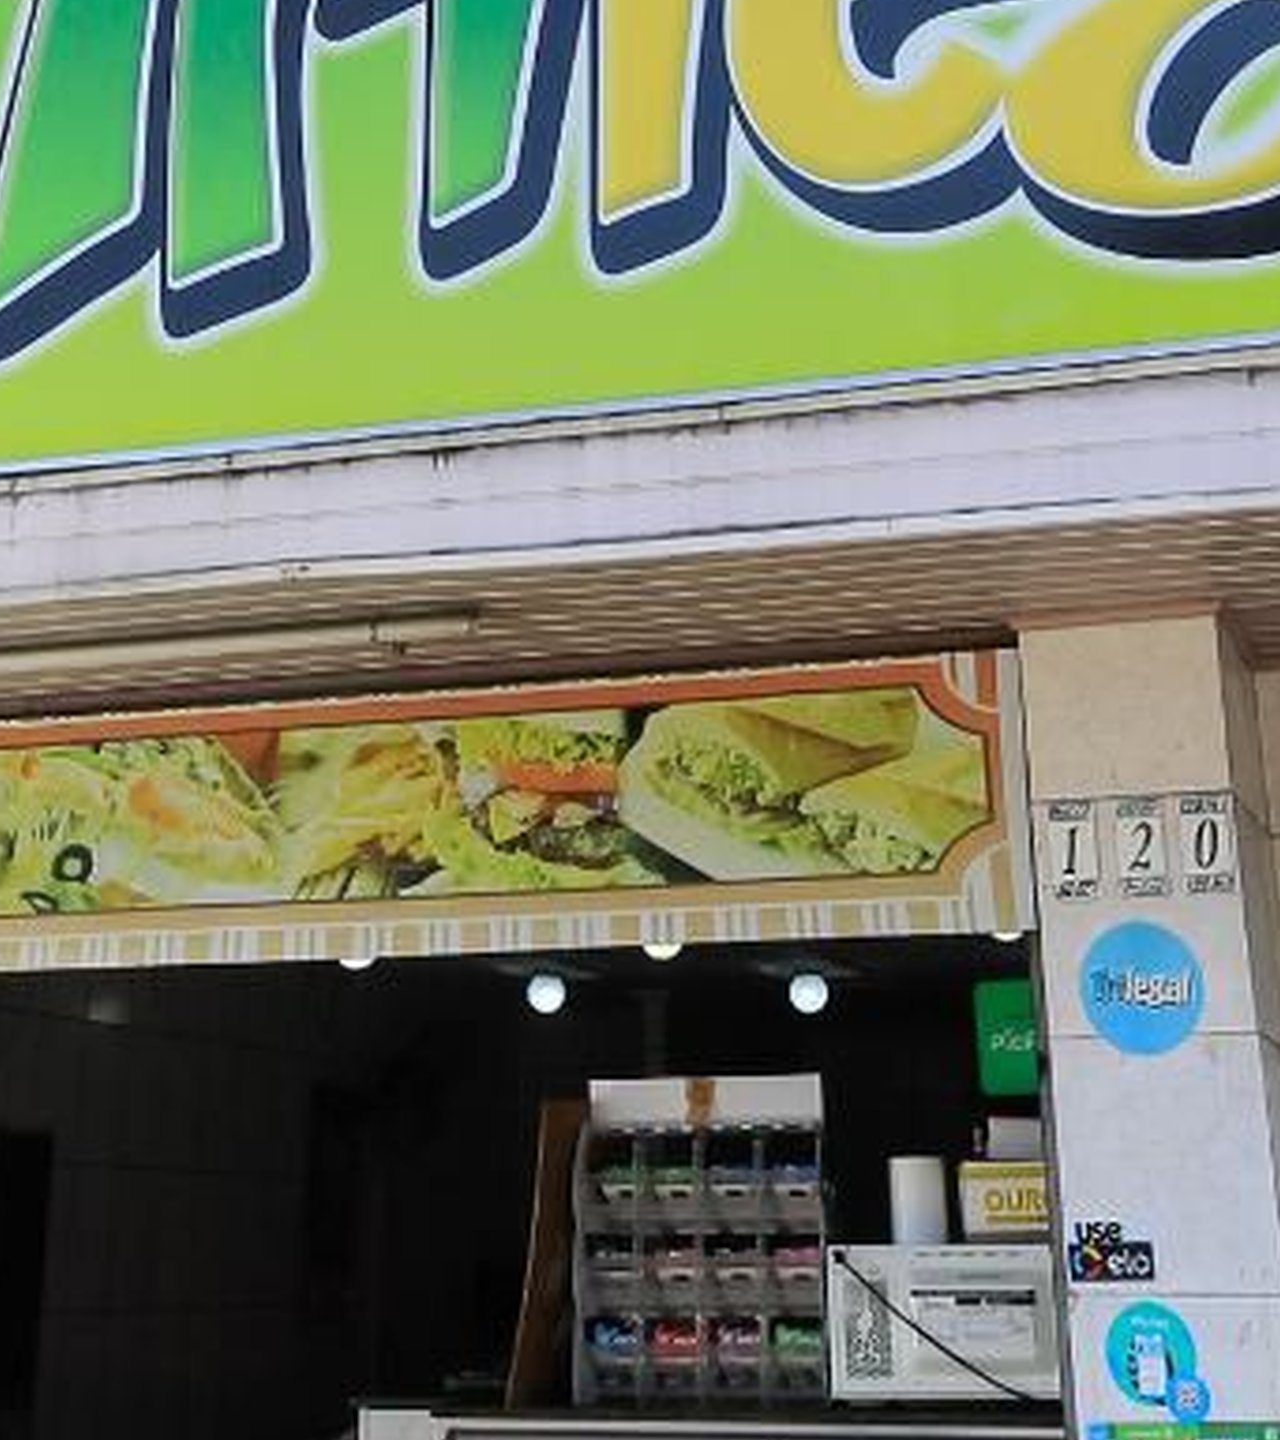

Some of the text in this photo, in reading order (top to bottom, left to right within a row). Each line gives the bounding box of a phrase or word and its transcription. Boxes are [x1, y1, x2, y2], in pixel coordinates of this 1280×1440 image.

[1062, 817, 1219, 875] 120
[984, 1187, 1050, 1212] OUR
[1074, 1221, 1122, 1245] use
[1107, 1249, 1151, 1277] elo
